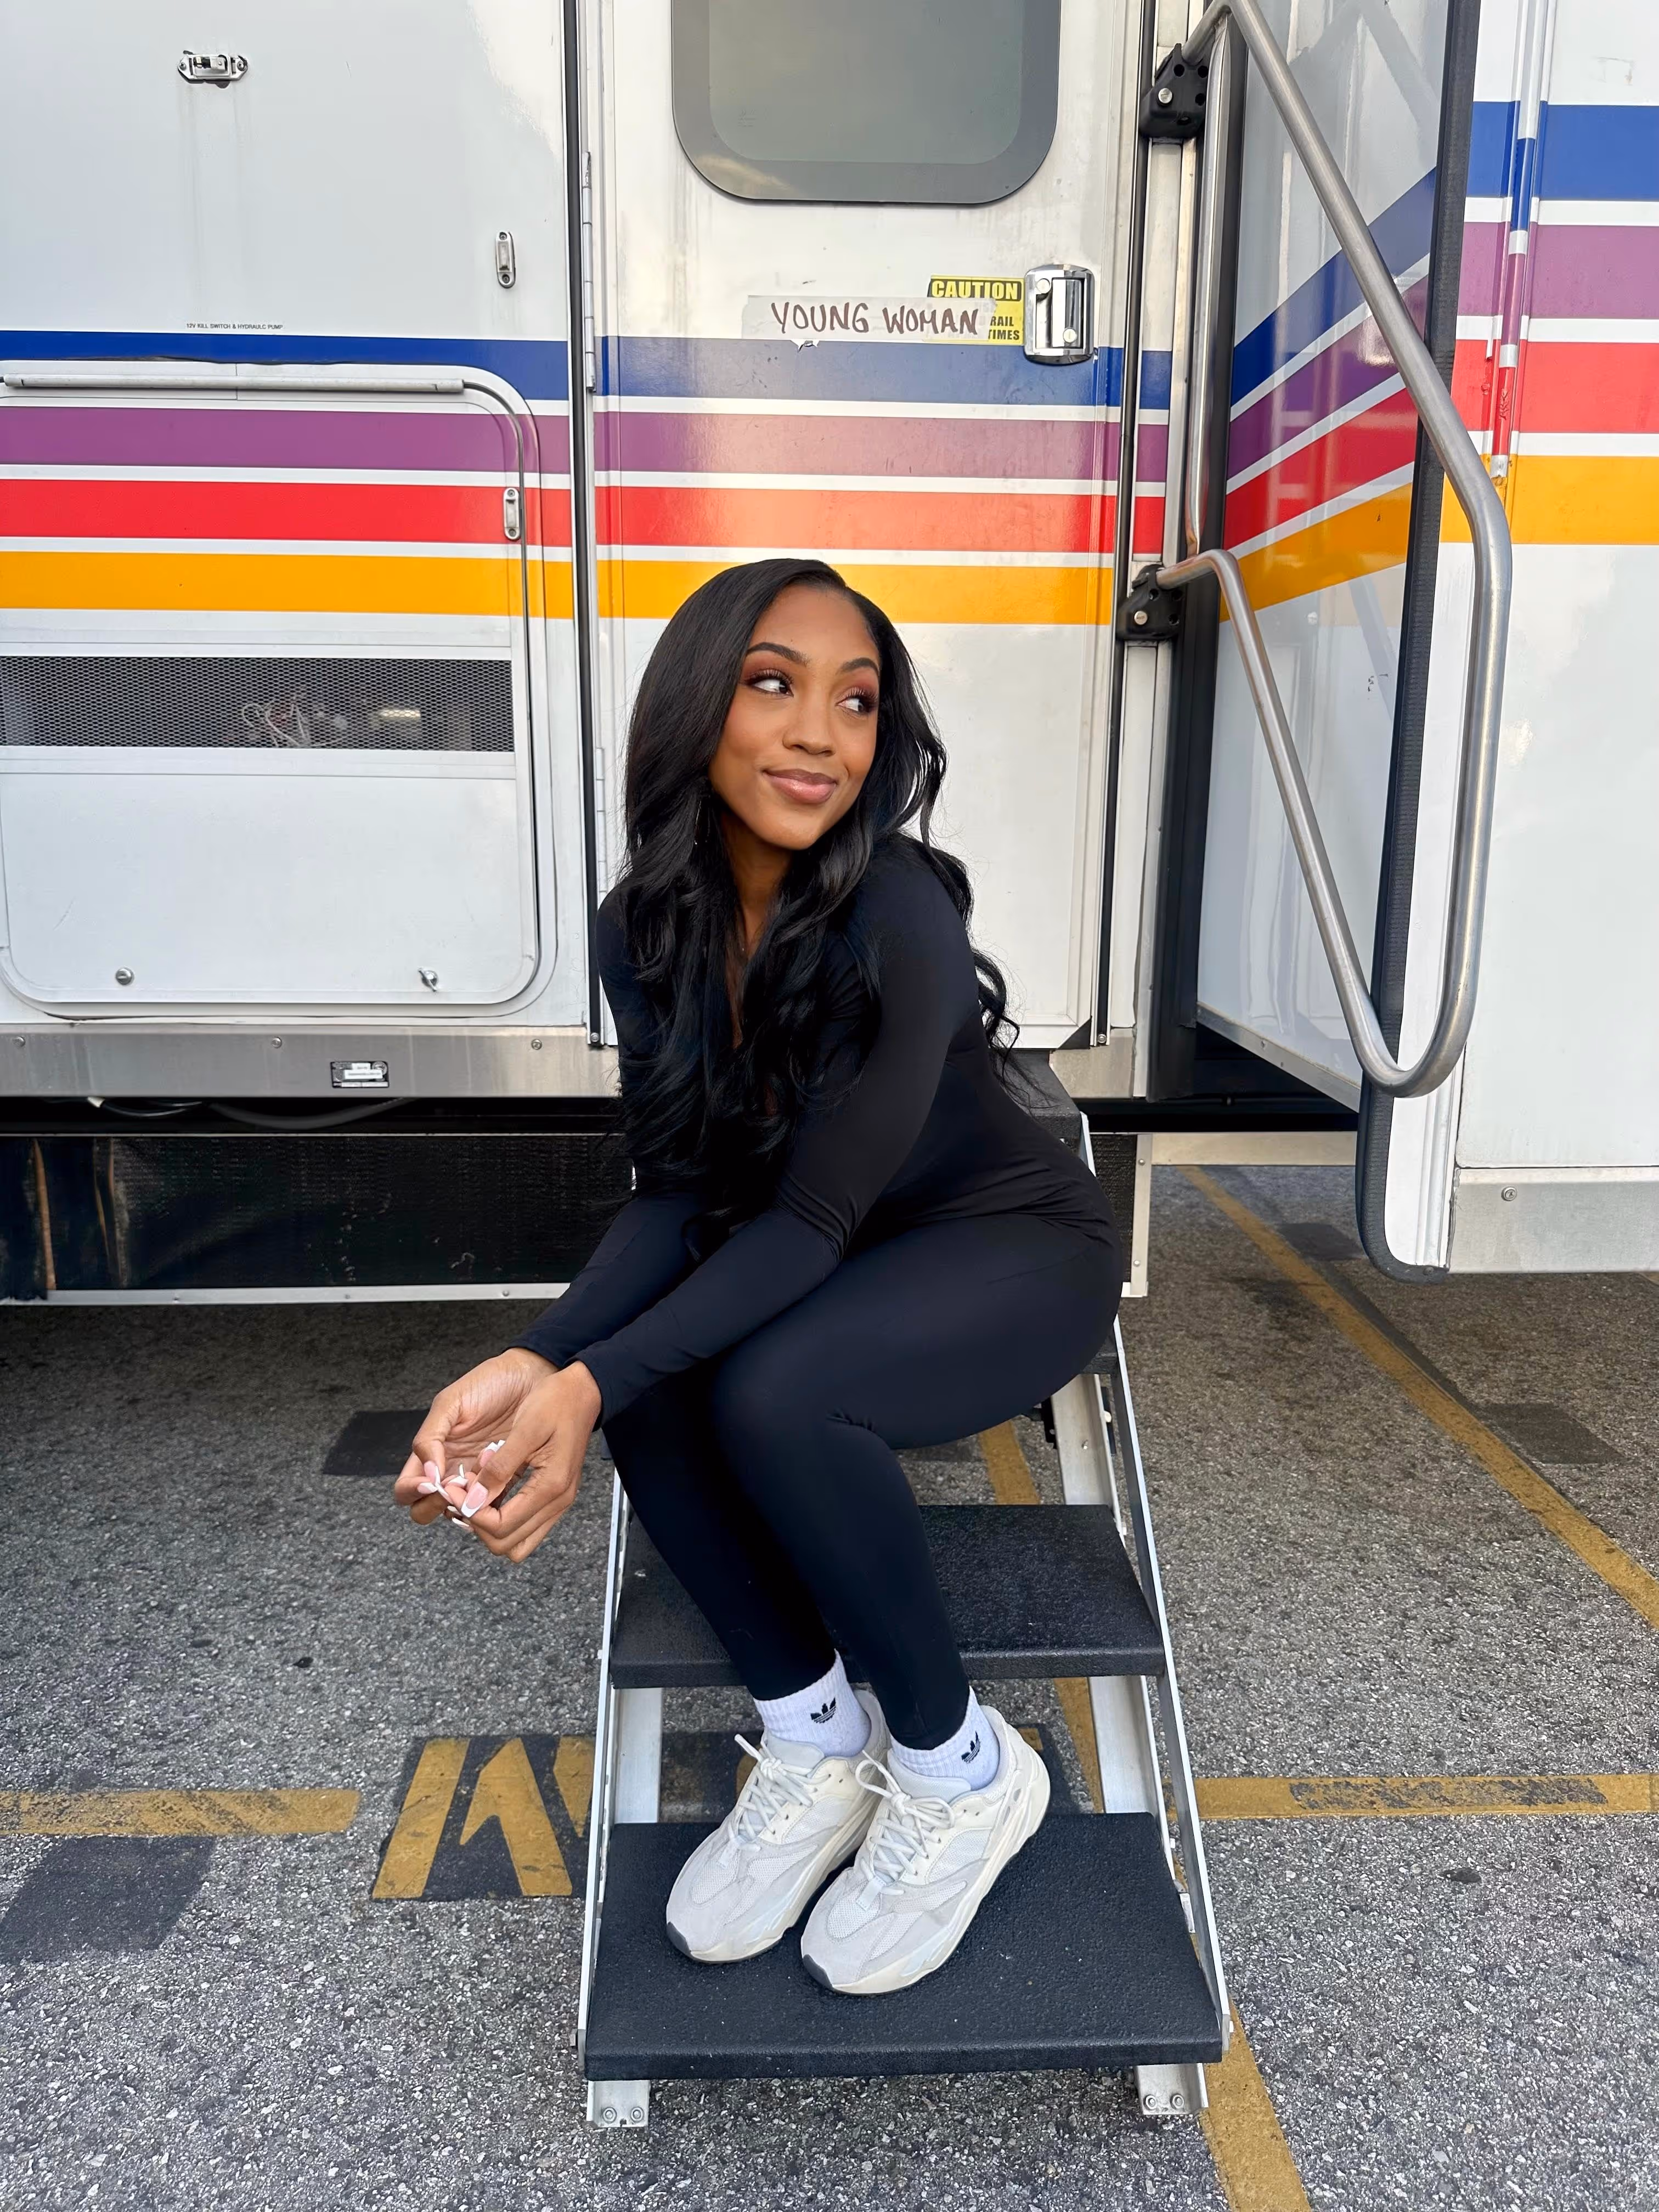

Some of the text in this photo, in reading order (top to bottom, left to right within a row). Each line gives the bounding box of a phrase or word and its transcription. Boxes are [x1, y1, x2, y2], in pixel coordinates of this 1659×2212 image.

[932, 280, 1018, 300] CAUTION
[771, 302, 869, 334] YOUNG
[882, 305, 979, 335] WOMAN
